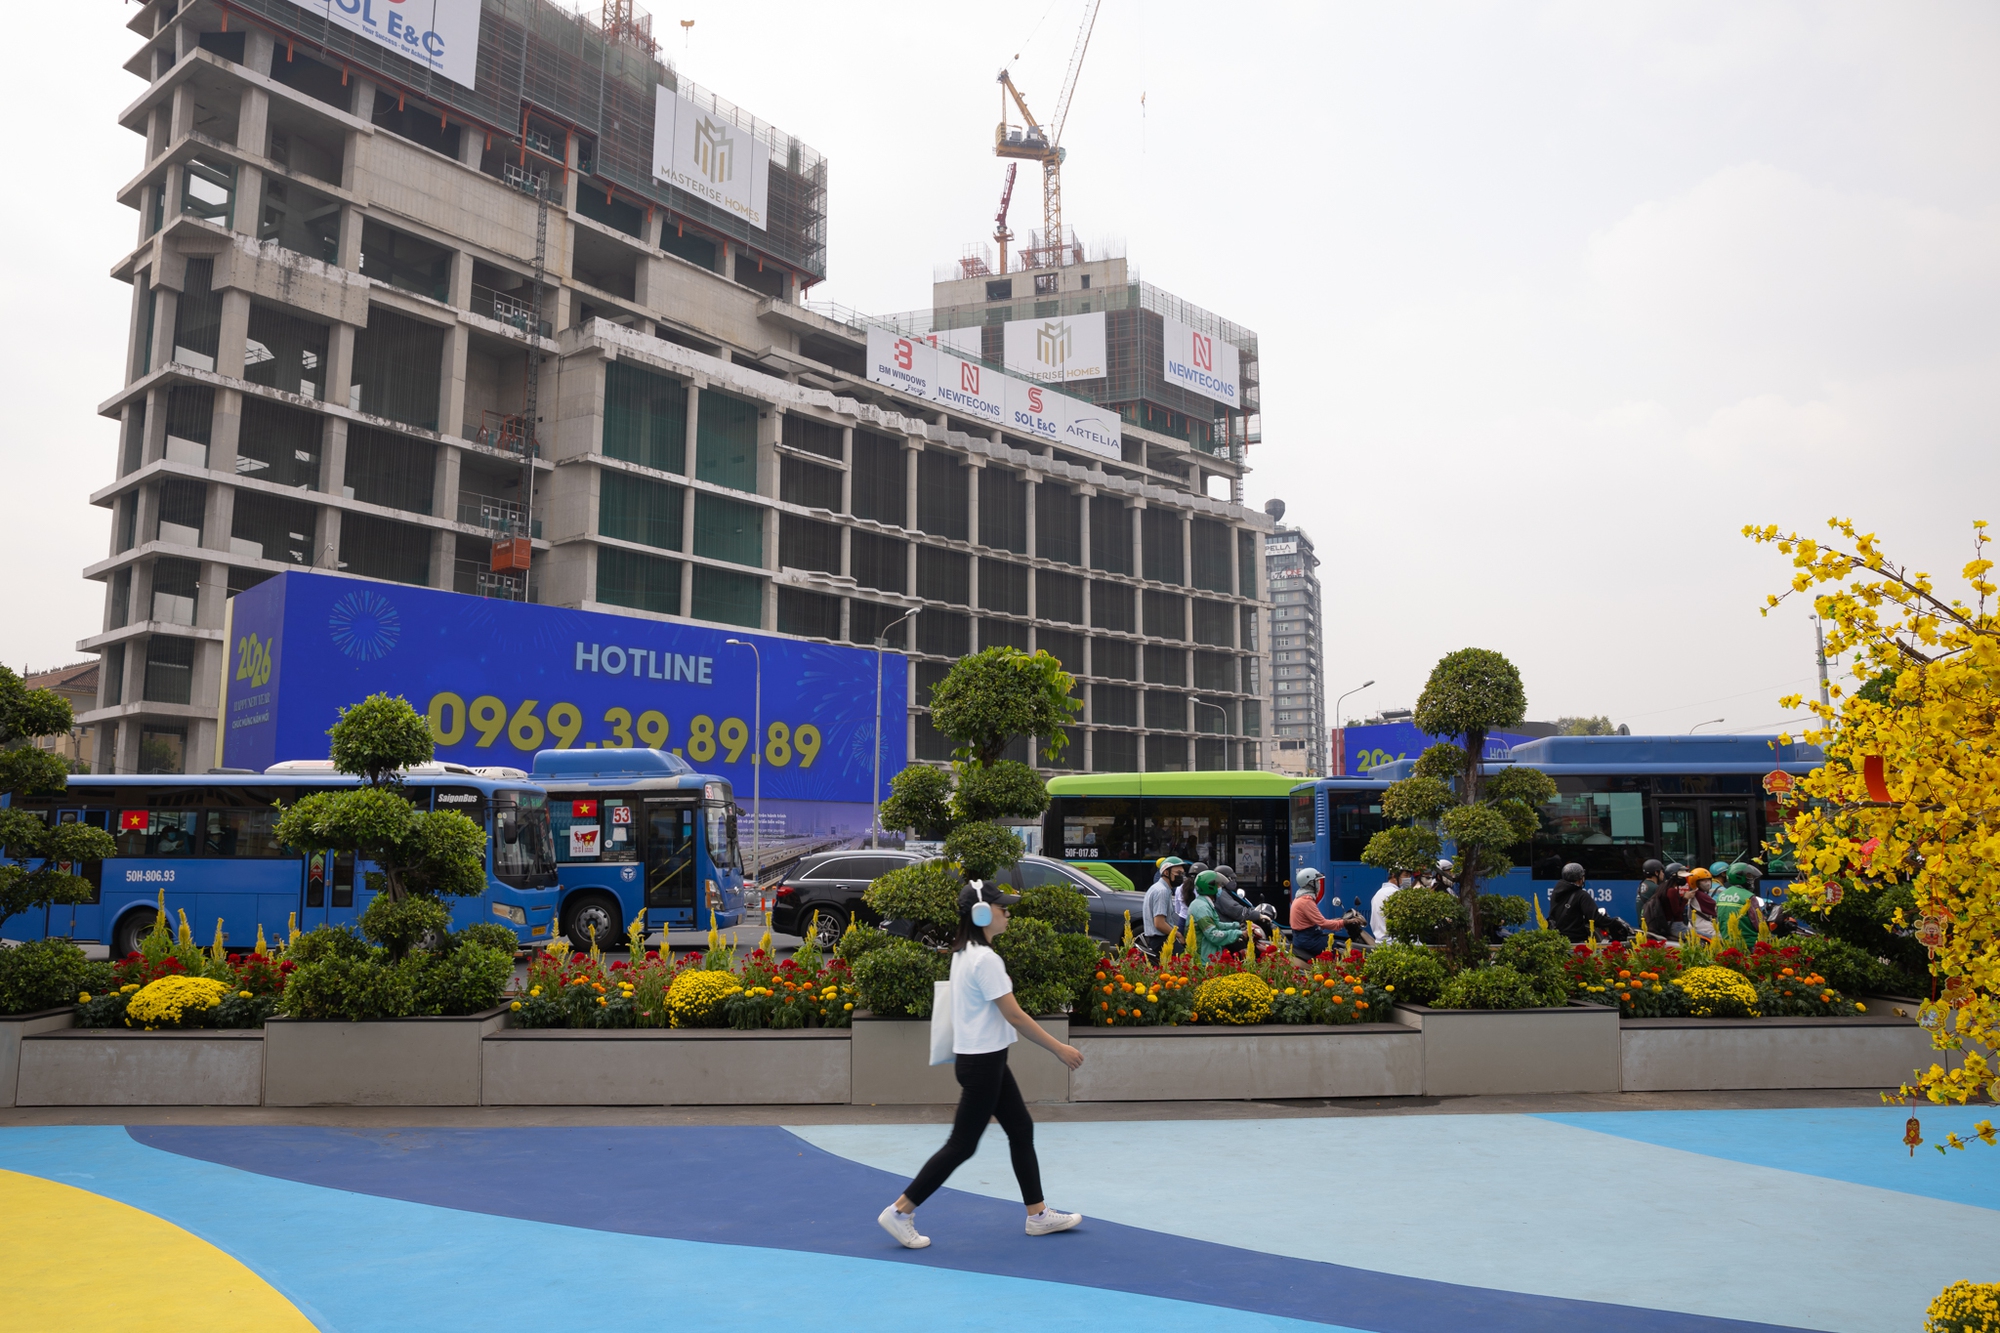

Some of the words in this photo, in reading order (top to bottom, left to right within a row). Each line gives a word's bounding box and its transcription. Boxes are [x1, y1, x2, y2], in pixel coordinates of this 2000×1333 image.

[322, 0, 377, 27] OL
[387, 9, 445, 58] E&C
[361, 24, 375, 36] Your
[375, 31, 398, 48] Success
[401, 44, 411, 54] Our
[411, 48, 444, 70] Achievement
[661, 165, 722, 204] MASTERISE
[724, 196, 760, 222] HOMES
[879, 364, 891, 376] BM
[892, 369, 927, 388] WINDOWS
[1066, 366, 1101, 378] HOMES
[1168, 360, 1235, 397] NEWTECONS
[938, 386, 1001, 416] NEWTECONS
[1014, 411, 1034, 428] SOL
[1037, 418, 1057, 434] E&C
[1066, 424, 1120, 449] ARTELIA
[236, 632, 273, 689] 2026
[575, 641, 713, 685] HOTLINE
[233, 699, 247, 712] HAPPY
[258, 692, 271, 705] YEAR
[427, 691, 822, 768] 0969.39.89.89
[1356, 748, 1407, 773] 20
[437, 793, 478, 803] SaigonBus
[613, 806, 630, 823] 53
[1065, 848, 1098, 857] 50F-017.85
[126, 870, 175, 882] 50H-806.93
[1718, 892, 1741, 903] Grab
